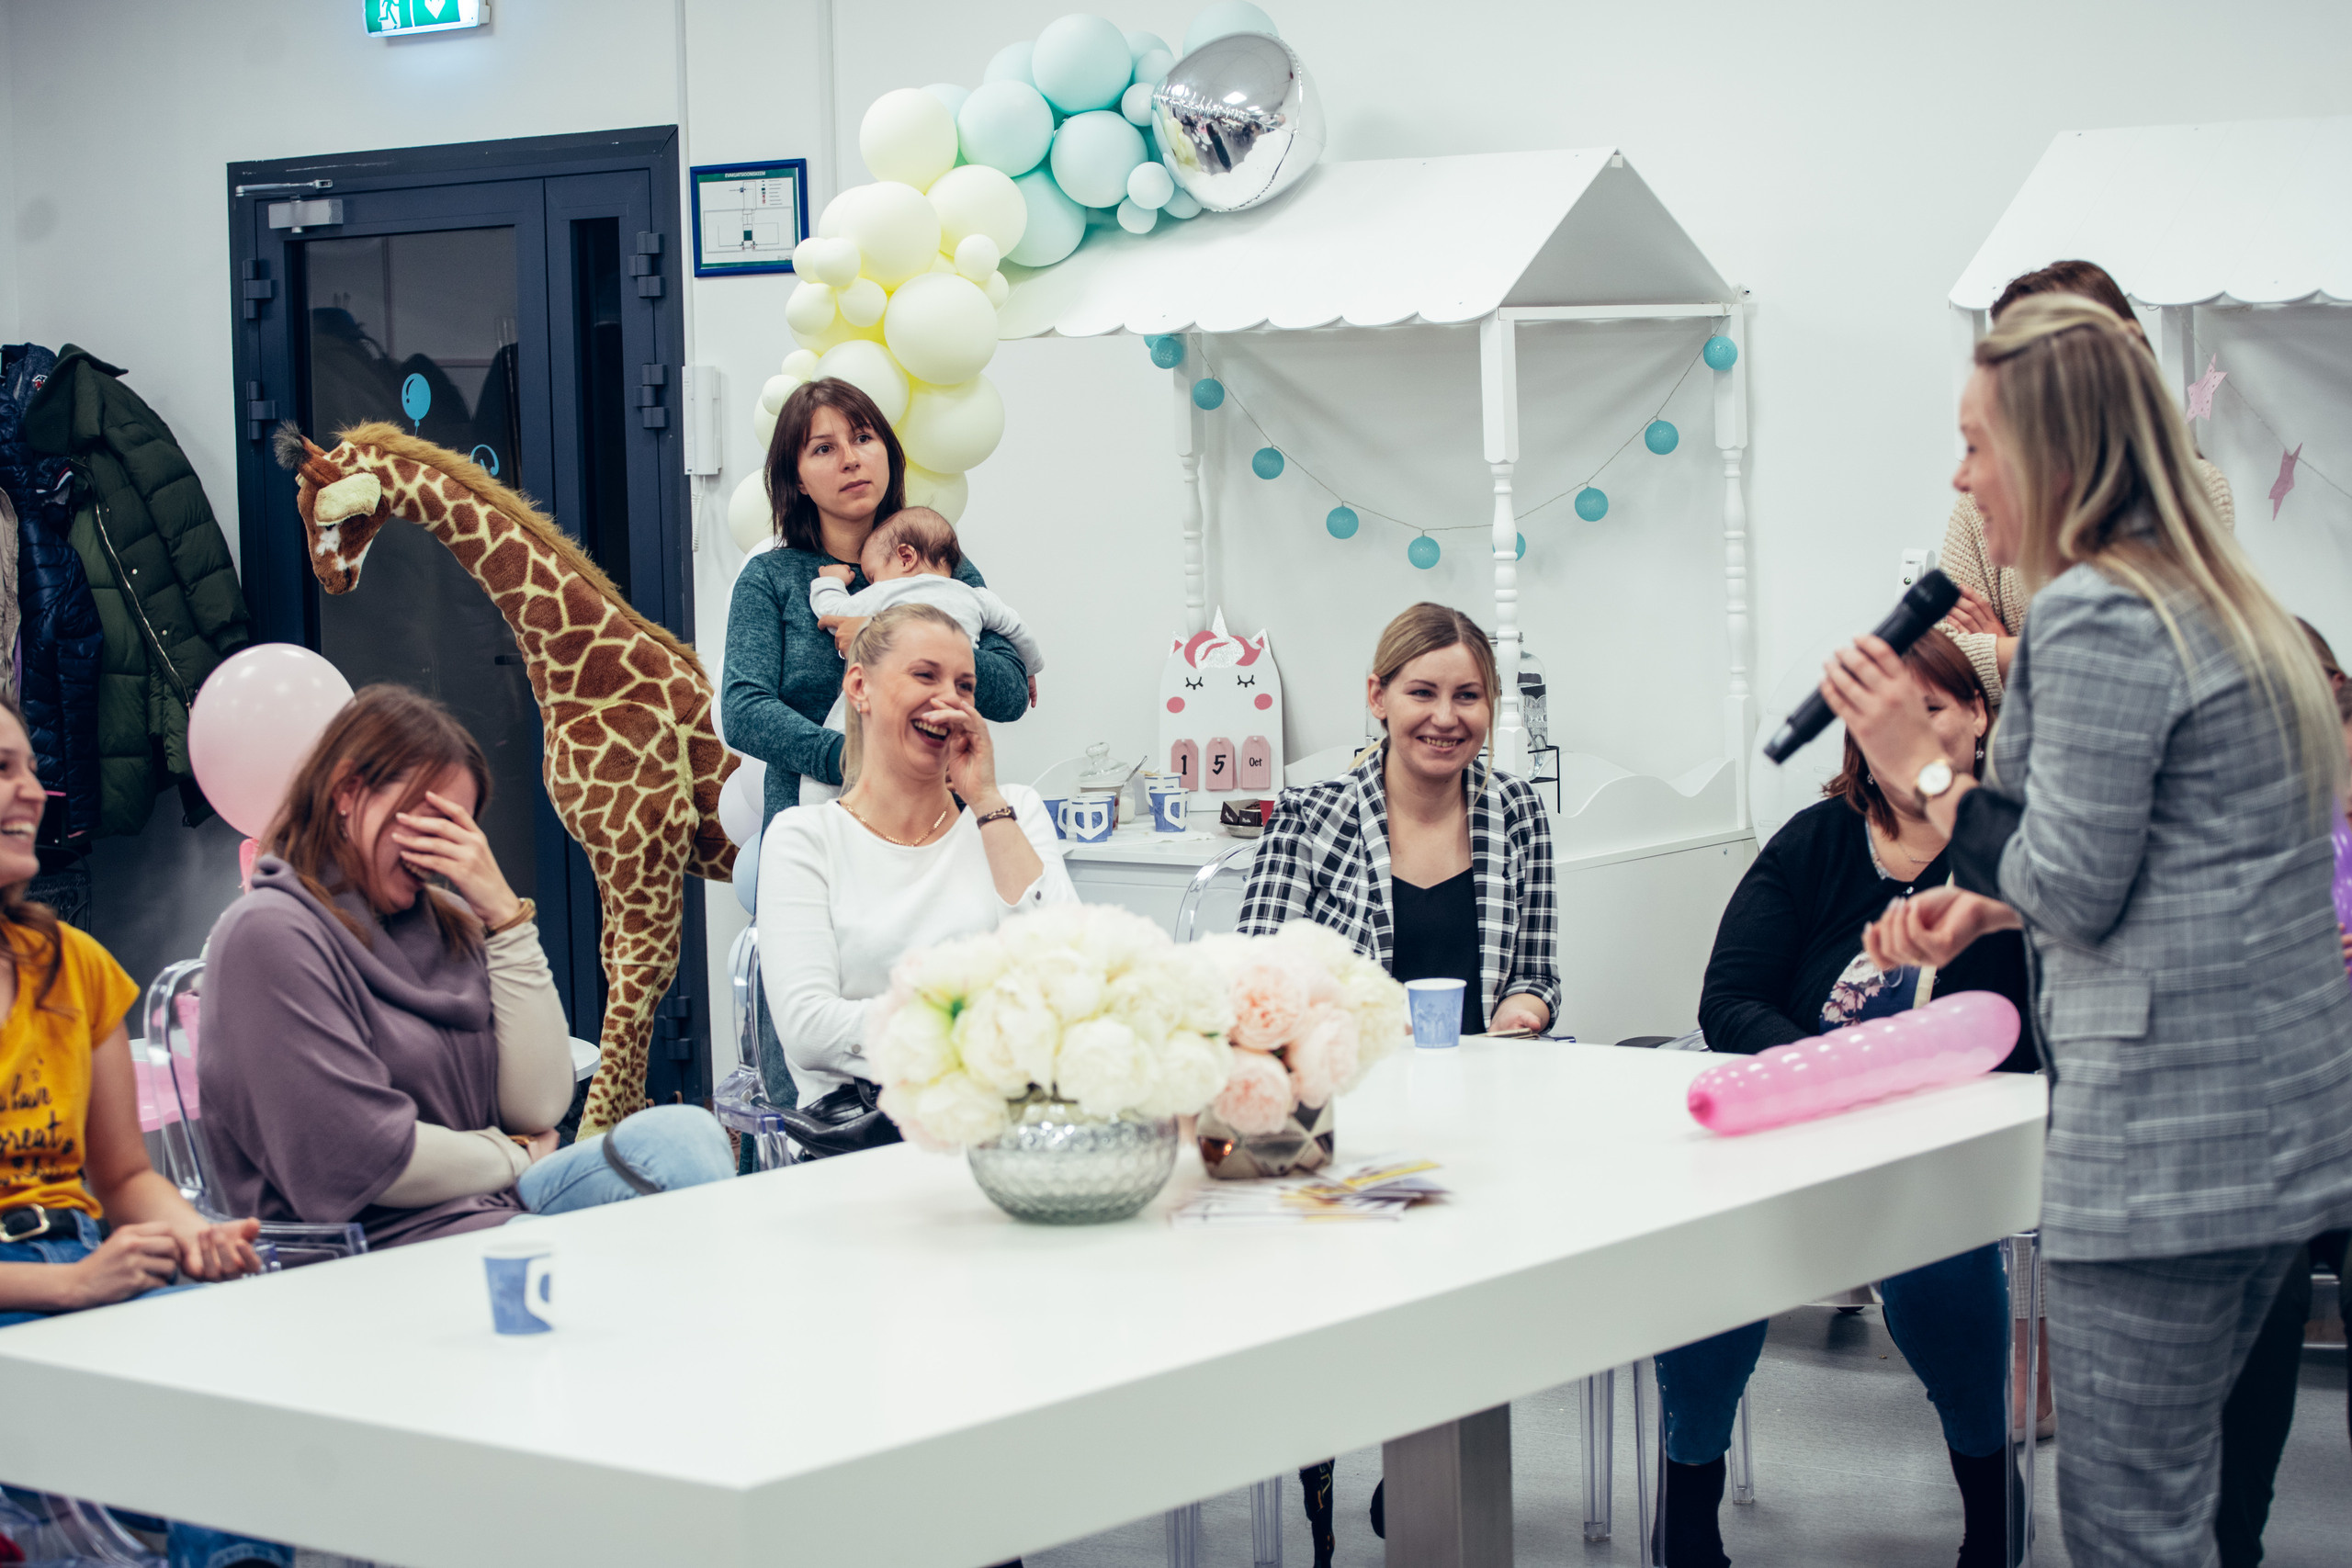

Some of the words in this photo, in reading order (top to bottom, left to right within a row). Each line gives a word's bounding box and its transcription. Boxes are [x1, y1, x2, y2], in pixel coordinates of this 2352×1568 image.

[1181, 754, 1187, 775] 1
[1212, 754, 1227, 775] 5
[1249, 757, 1262, 767] Oct
